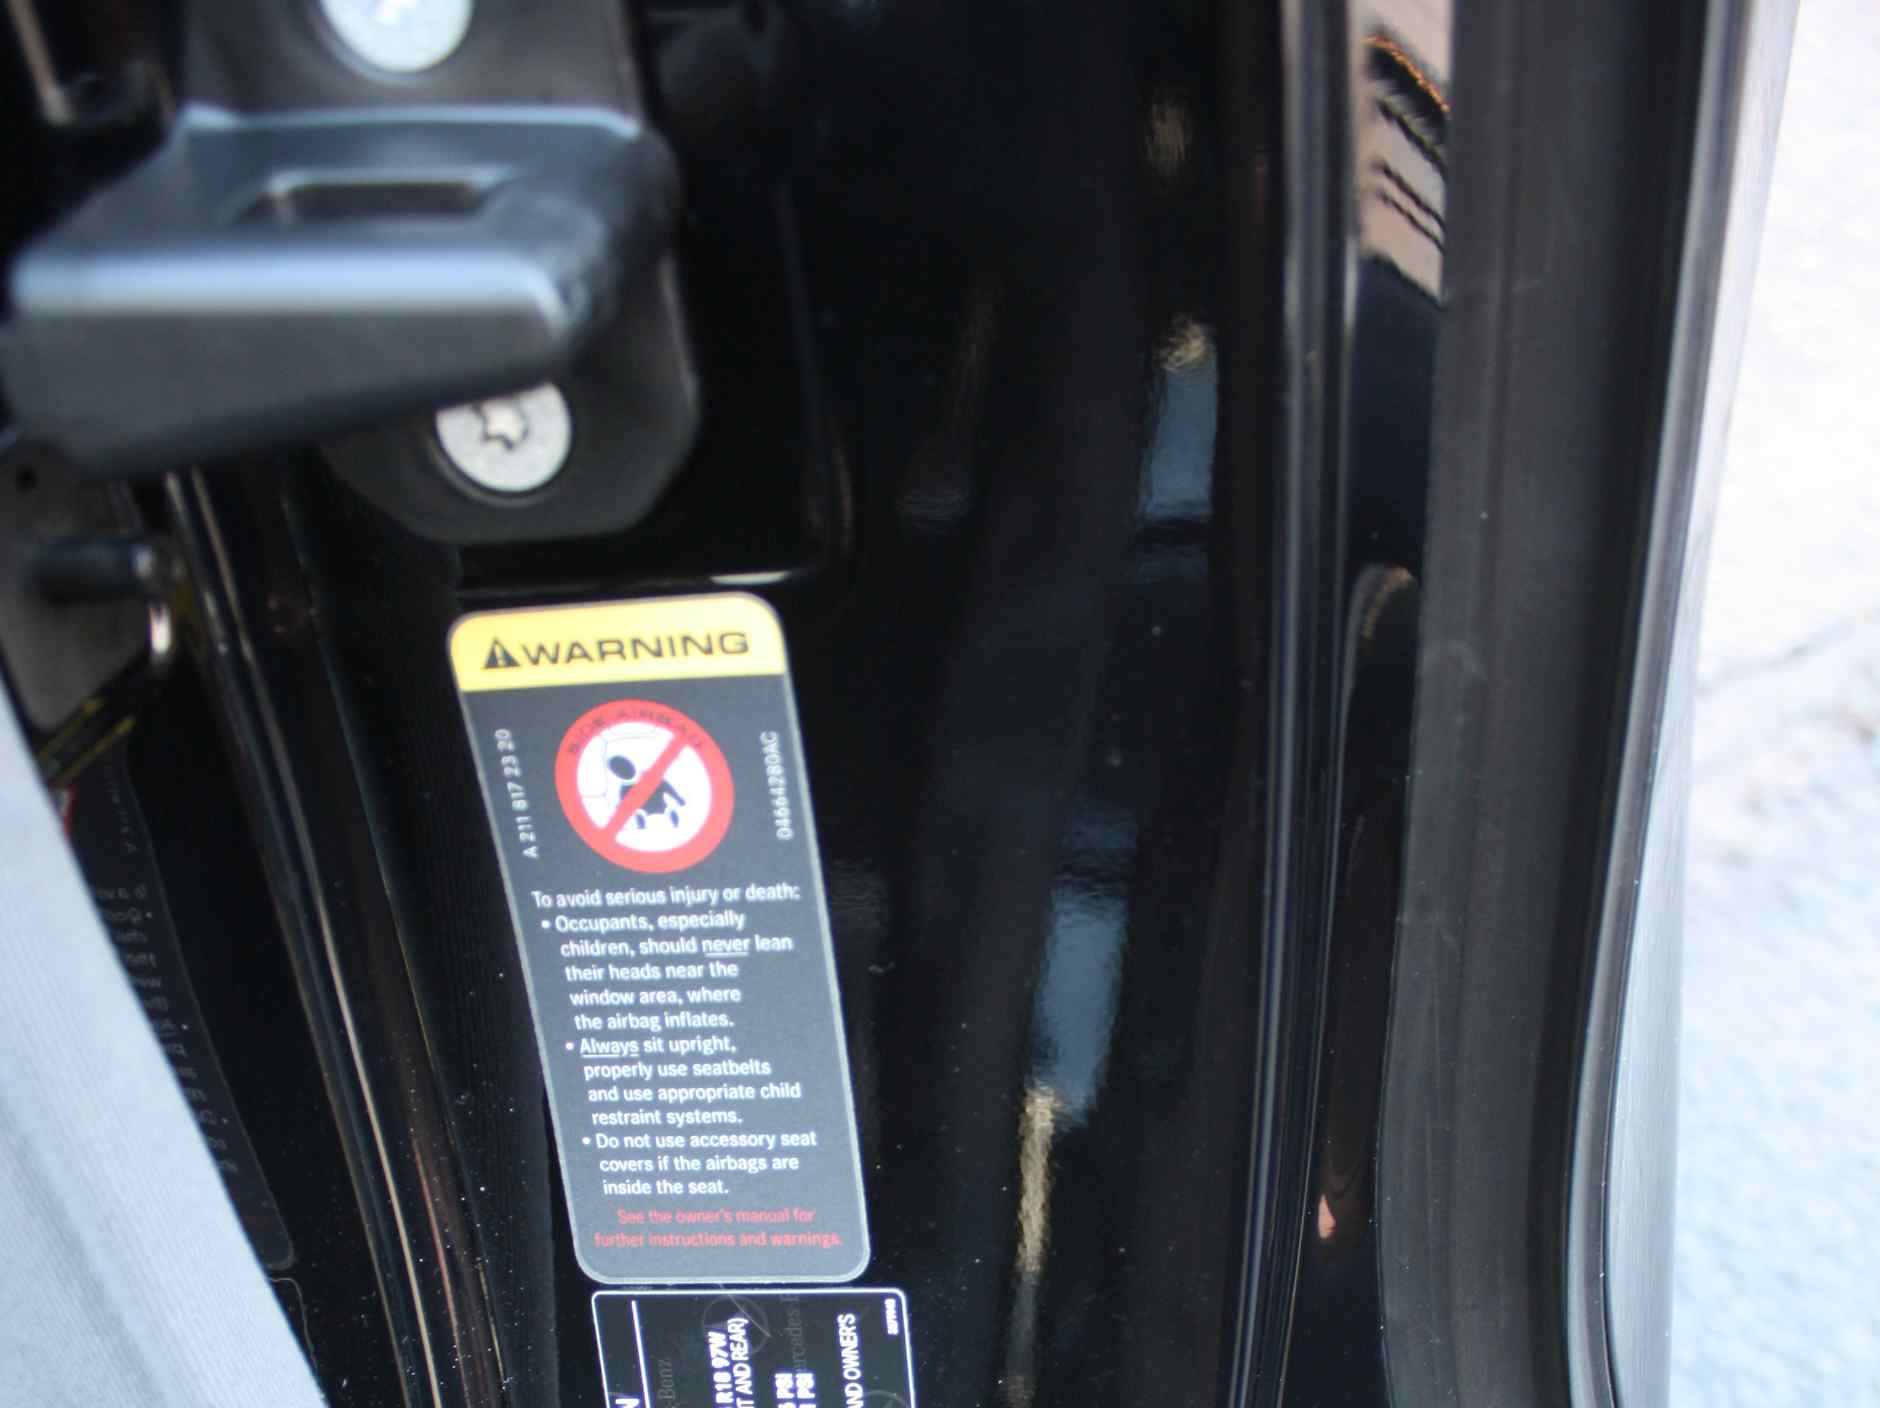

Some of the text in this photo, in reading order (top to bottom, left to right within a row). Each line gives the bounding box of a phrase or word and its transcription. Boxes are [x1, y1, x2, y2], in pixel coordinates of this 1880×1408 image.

[523, 632, 749, 665] WARNING
[494, 728, 539, 859] A 211 817 23 20
[531, 883, 800, 908] To avoid serious injury or death:
[555, 910, 746, 933] Occupants, especially
[560, 935, 793, 957] children, should never lean
[565, 961, 738, 981] their heads near the
[570, 986, 741, 1006] window area, where
[575, 1011, 734, 1033] the airbag inflates.
[581, 1035, 737, 1057] Always sit upright,
[584, 1059, 771, 1081] properly use seatbelts
[588, 1082, 801, 1105] and use appropriate child
[592, 1108, 743, 1129] restraint systems.
[596, 1131, 817, 1152] Do not use accessory seat
[600, 1154, 799, 1175] covers if the airbags are
[603, 1178, 729, 1195] inside the seat.
[617, 1206, 815, 1224] See the owner's manual for
[595, 1231, 842, 1250] further instructions and warnings.
[708, 1331, 730, 1368] 97W
[727, 1317, 749, 1361] REAR)
[837, 1314, 861, 1380] OWNER'S
[713, 1371, 734, 1403] R18
[733, 1363, 753, 1394] AND
[775, 1373, 795, 1399] PSI
[795, 1373, 815, 1399] PSI
